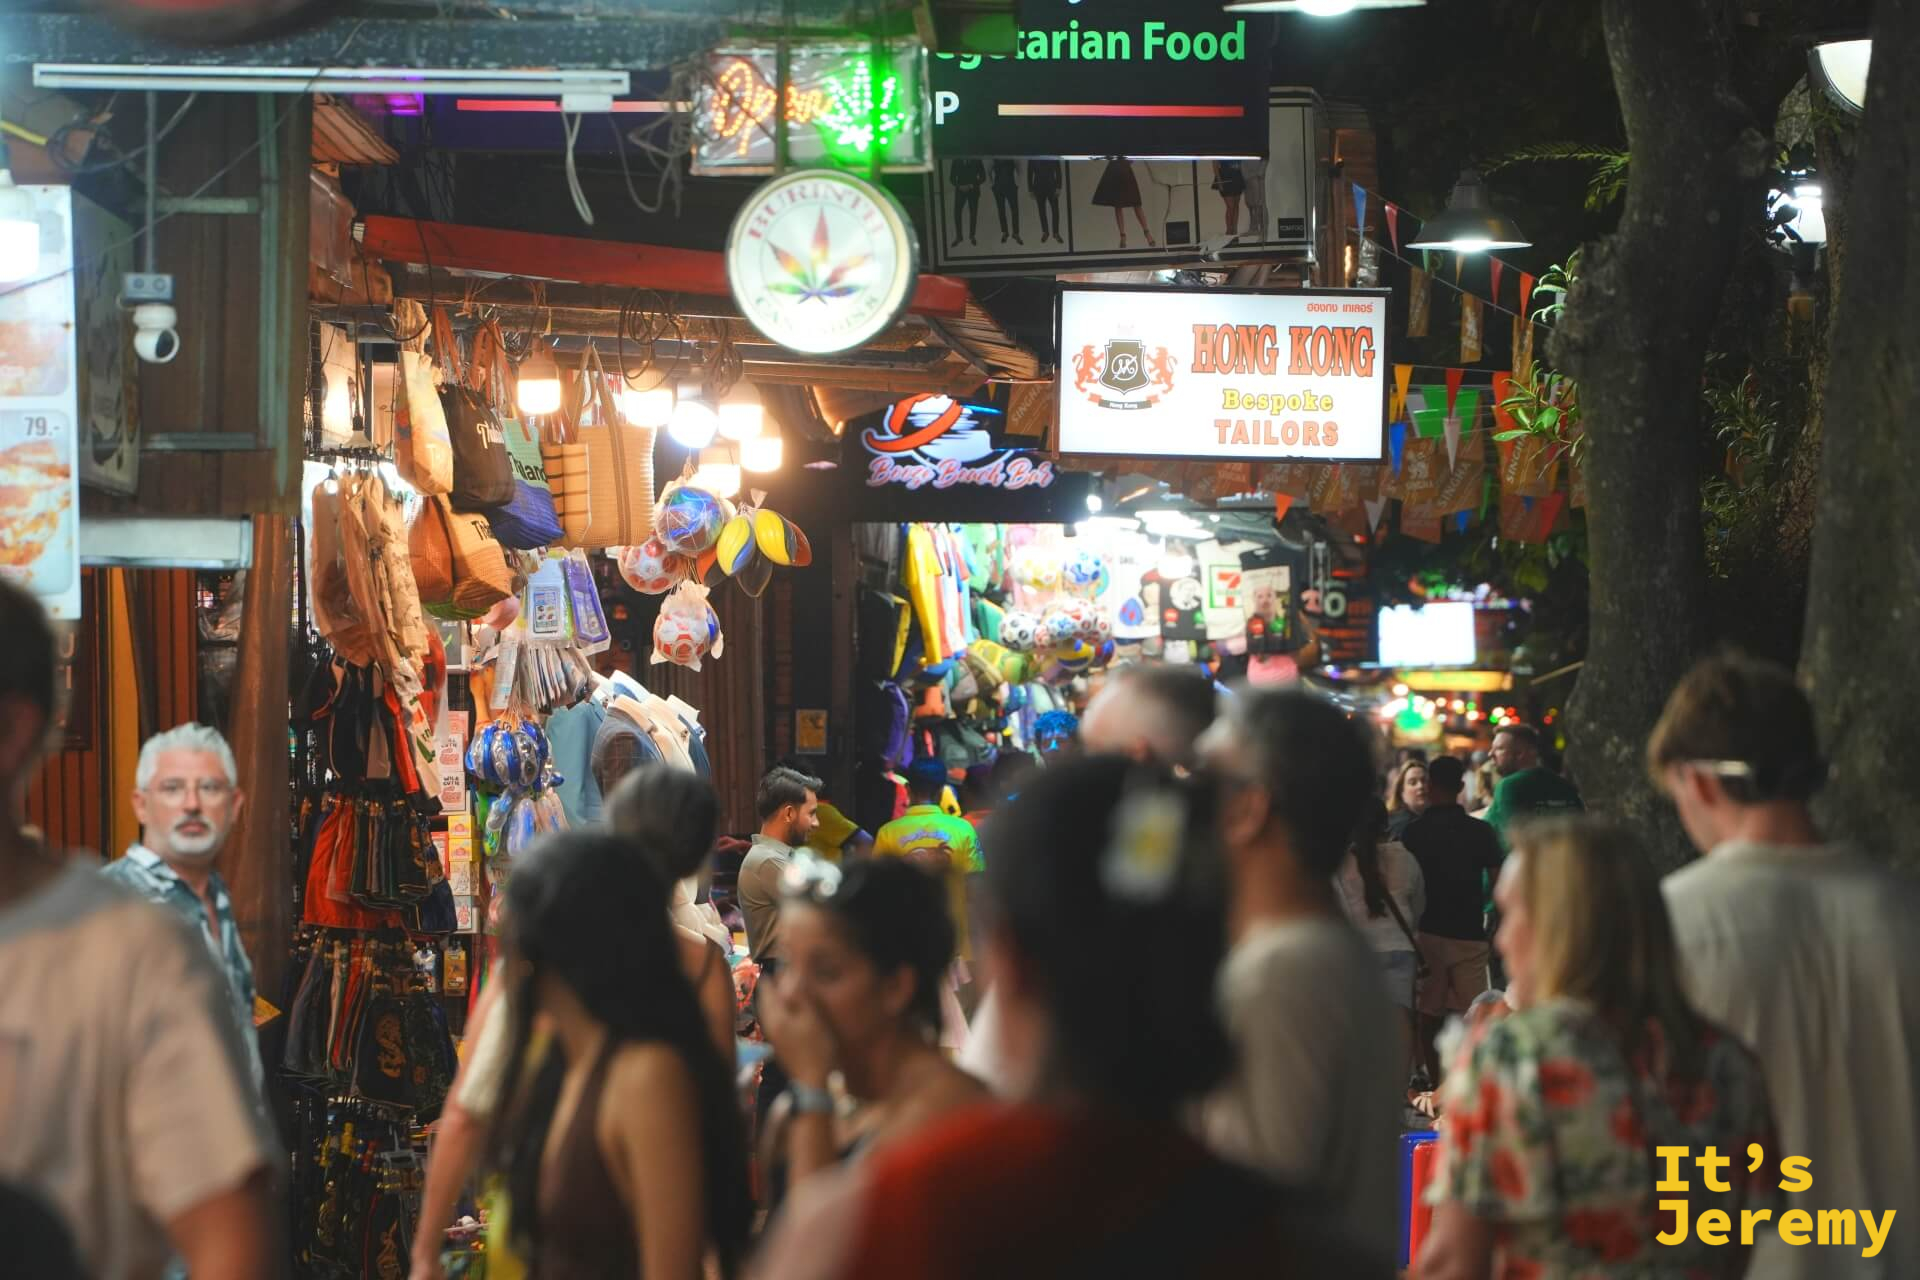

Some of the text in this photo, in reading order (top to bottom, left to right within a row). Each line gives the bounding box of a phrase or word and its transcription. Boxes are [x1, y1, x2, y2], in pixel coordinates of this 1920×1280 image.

[1143, 20, 1246, 61] Food
[1191, 323, 1375, 377] HONG KONG
[1222, 388, 1334, 415] Bespoke
[24, 416, 60, 437] 79.-
[1214, 419, 1339, 447] TAILORS
[865, 455, 1056, 491] Booze Beach Bar
[1313, 465, 1332, 499] SING
